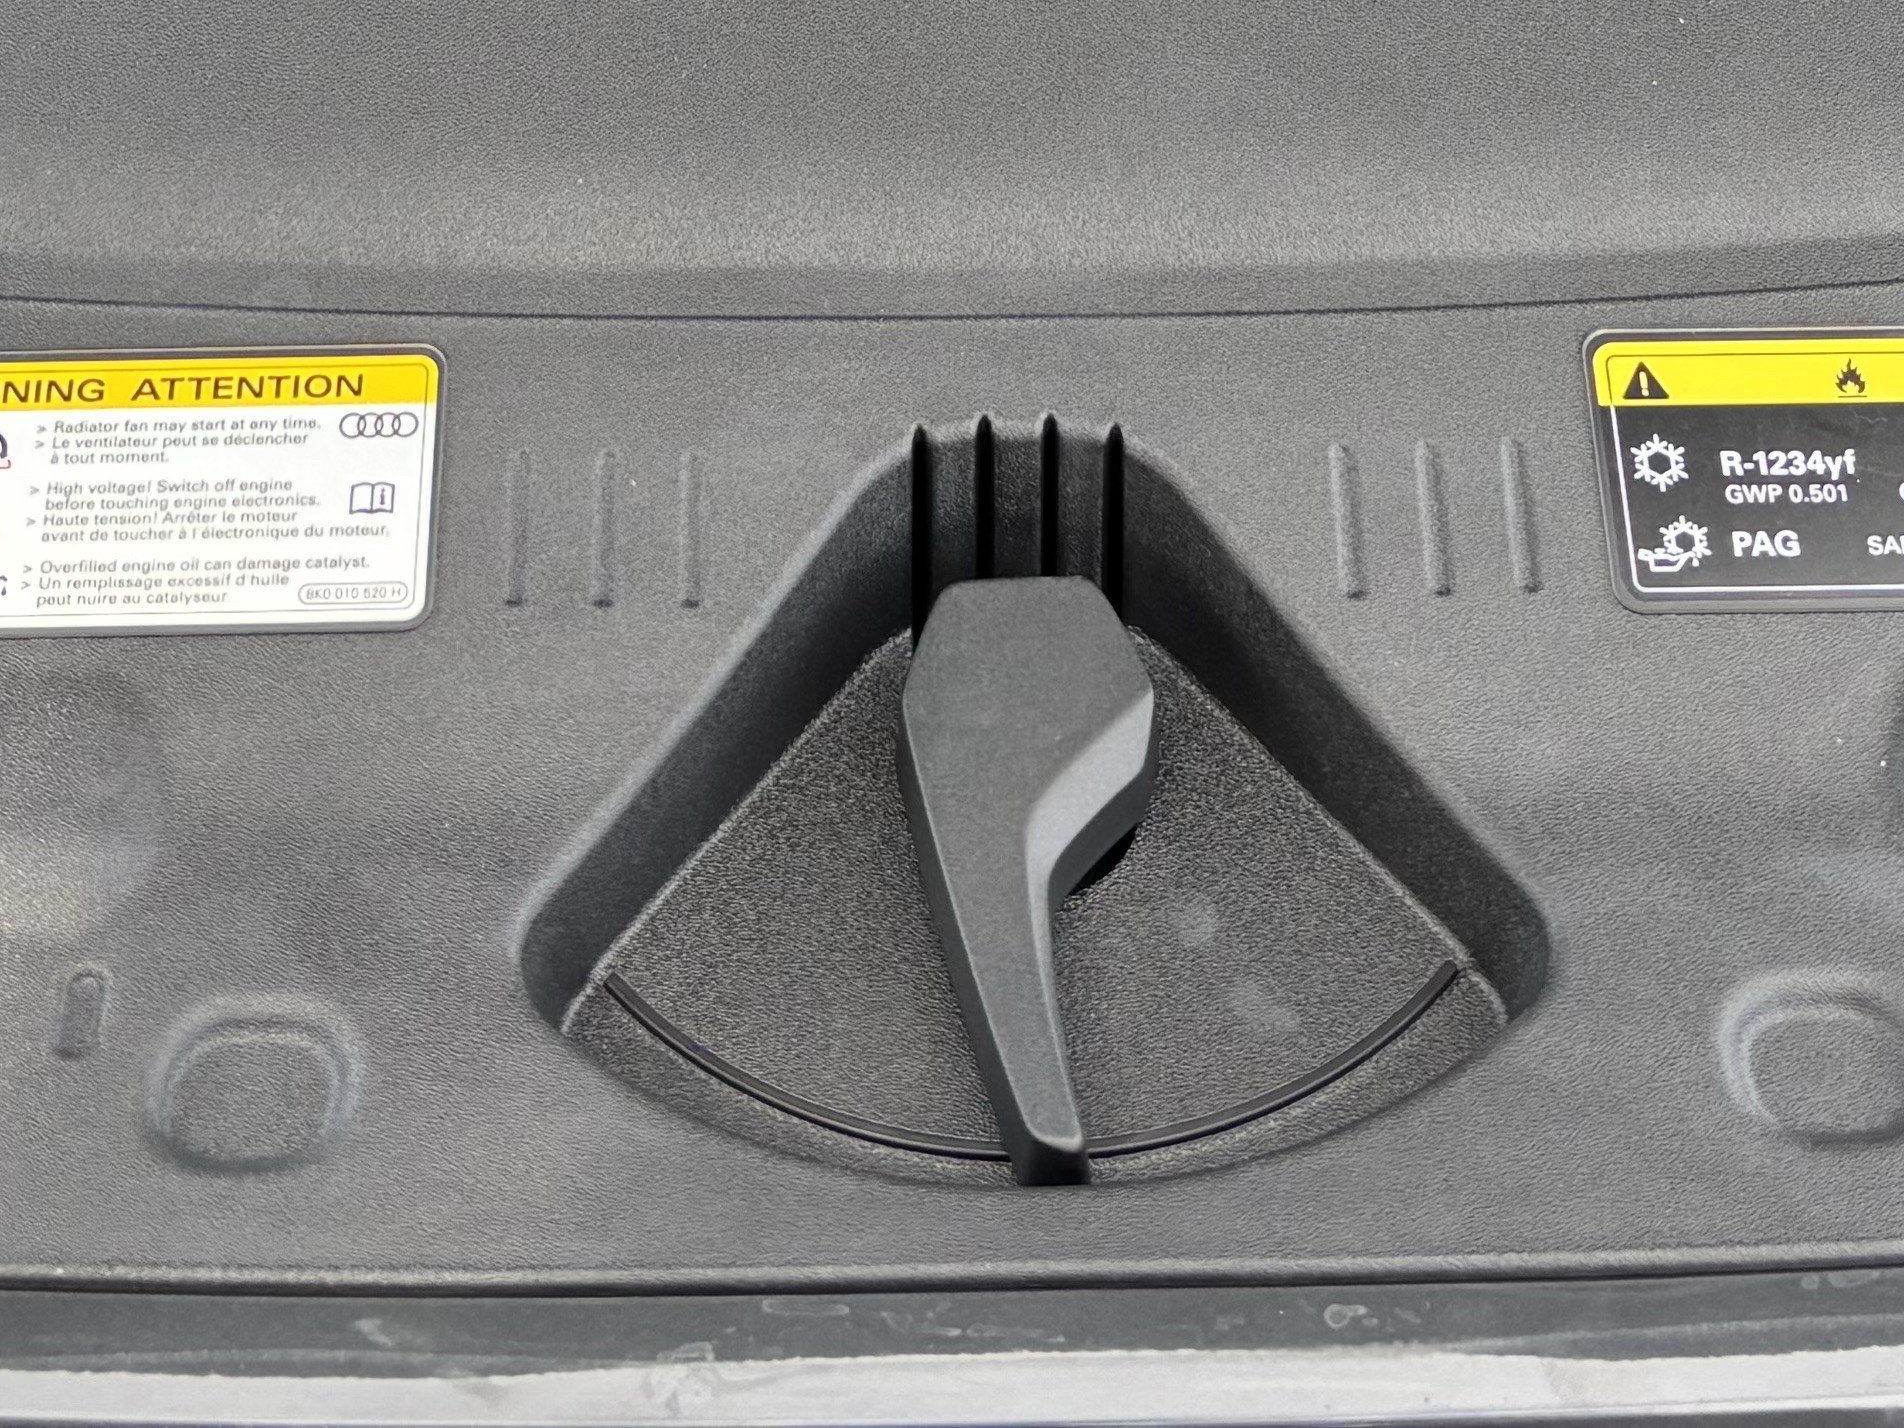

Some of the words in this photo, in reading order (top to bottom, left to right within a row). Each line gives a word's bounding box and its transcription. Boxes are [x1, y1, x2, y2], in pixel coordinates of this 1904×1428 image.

[130, 373, 365, 402] ATTENTION
[54, 420, 120, 434] Radiator
[124, 420, 148, 432] fan
[152, 420, 186, 433] may
[191, 418, 226, 431] start
[230, 418, 245, 430] at
[249, 420, 276, 432] any
[282, 416, 322, 430] time.
[52, 437, 70, 450] Le
[74, 435, 157, 448] ventilateur
[162, 435, 196, 450] peut
[202, 436, 218, 446] se
[224, 432, 308, 446] déclencher
[64, 452, 95, 464] tout
[100, 451, 170, 464] moment.
[1719, 448, 1857, 480] R-1234yf
[46, 481, 82, 497] High
[88, 480, 151, 496] voltage!
[157, 479, 210, 493] Switch
[214, 479, 235, 492] off
[240, 479, 293, 495] engine
[1724, 484, 1783, 505] GWP
[1788, 483, 1849, 504] 0.501
[45, 496, 96, 510] before
[100, 496, 169, 512] touching
[173, 495, 226, 510] engine
[231, 493, 321, 507] electronics.
[43, 513, 89, 527] Haute
[95, 511, 158, 526] tension!
[162, 510, 216, 524] Arrêter
[222, 510, 236, 523] le
[241, 510, 298, 523] moteur
[40, 528, 86, 542] avant
[90, 528, 108, 542] de
[114, 527, 174, 540] toucher
[304, 524, 324, 538] du
[330, 524, 390, 537] moteur.
[1731, 529, 1801, 557] PAG
[39, 560, 118, 574] Overfilled
[121, 560, 175, 575] engine
[180, 558, 199, 572] oil
[204, 559, 232, 571] can
[236, 556, 301, 573] damage
[305, 555, 371, 572] catalyst.
[39, 577, 61, 590] Un
[66, 575, 162, 592] remplissage
[167, 574, 230, 588] excessif
[36, 593, 72, 608] peut
[77, 592, 118, 605] nuire
[122, 592, 141, 605] au
